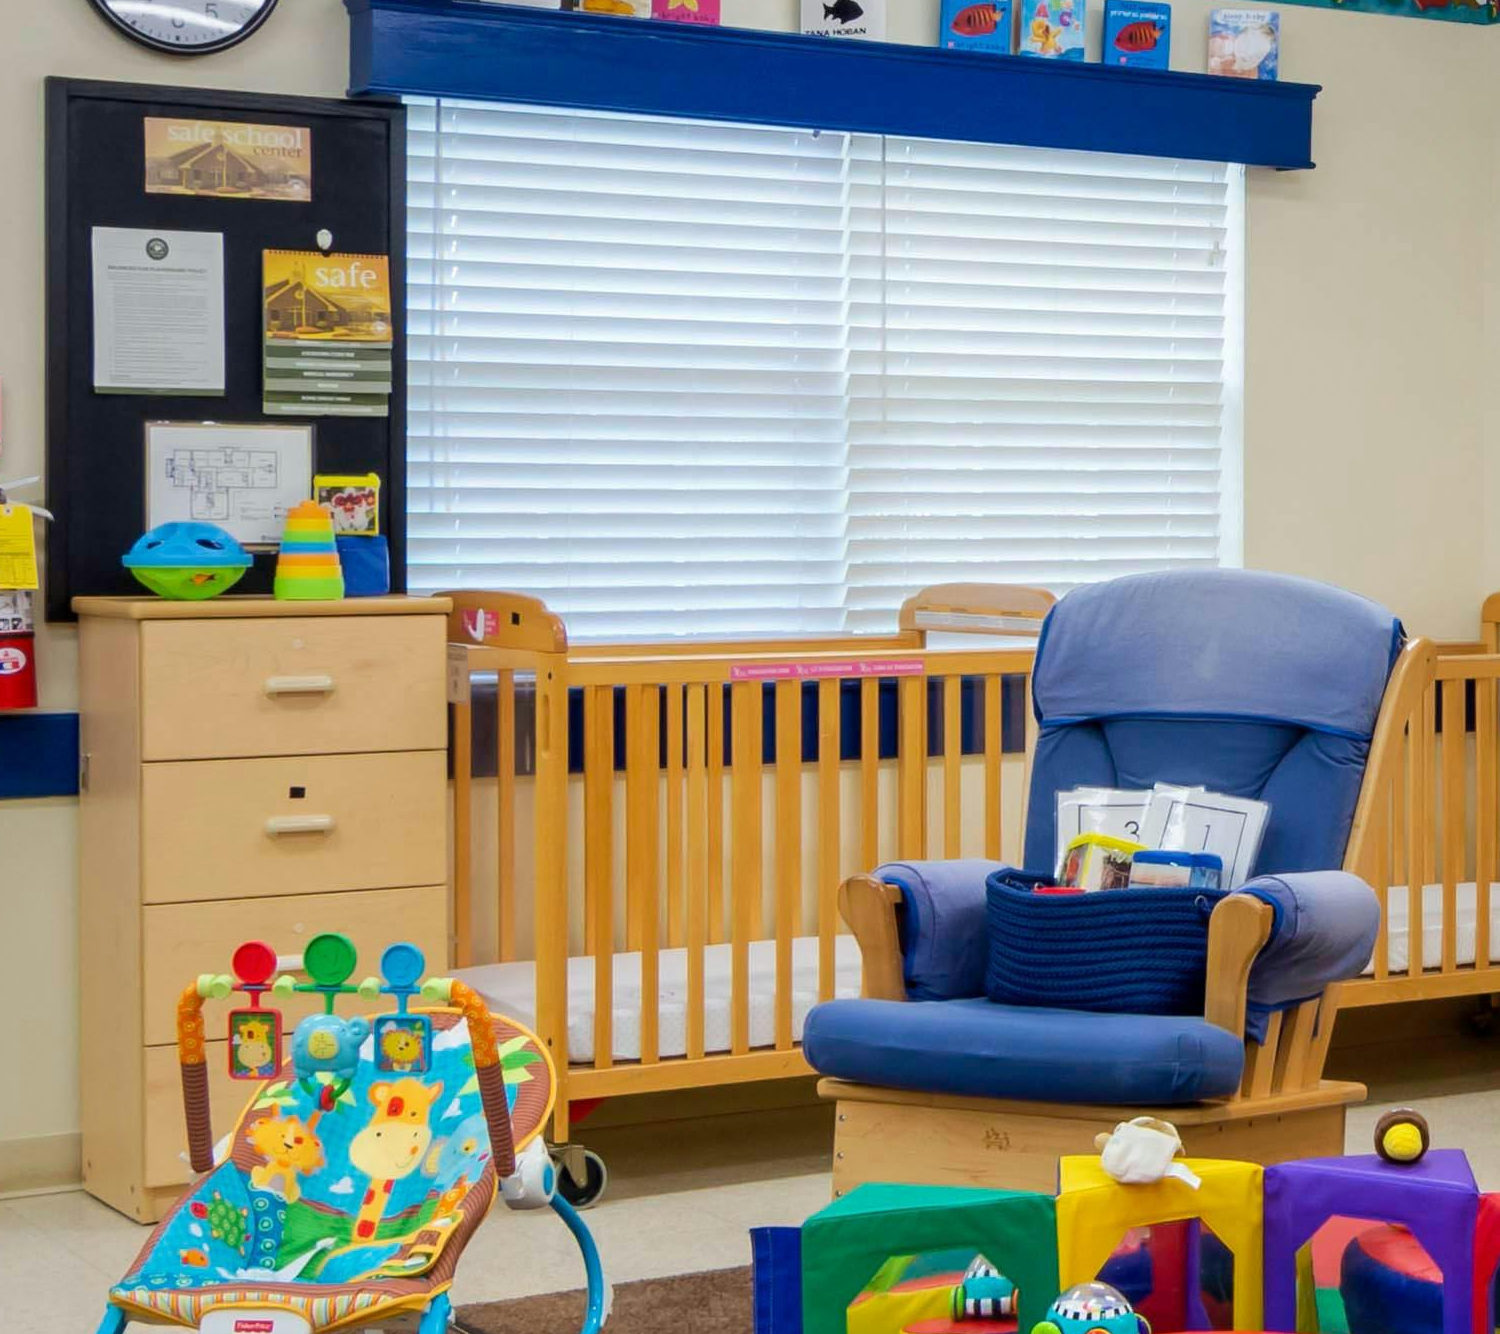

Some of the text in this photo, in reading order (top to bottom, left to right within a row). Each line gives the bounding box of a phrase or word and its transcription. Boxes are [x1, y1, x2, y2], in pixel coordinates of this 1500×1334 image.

[167, 123, 303, 149] safe school
[252, 145, 303, 159] center
[315, 261, 378, 289] safe
